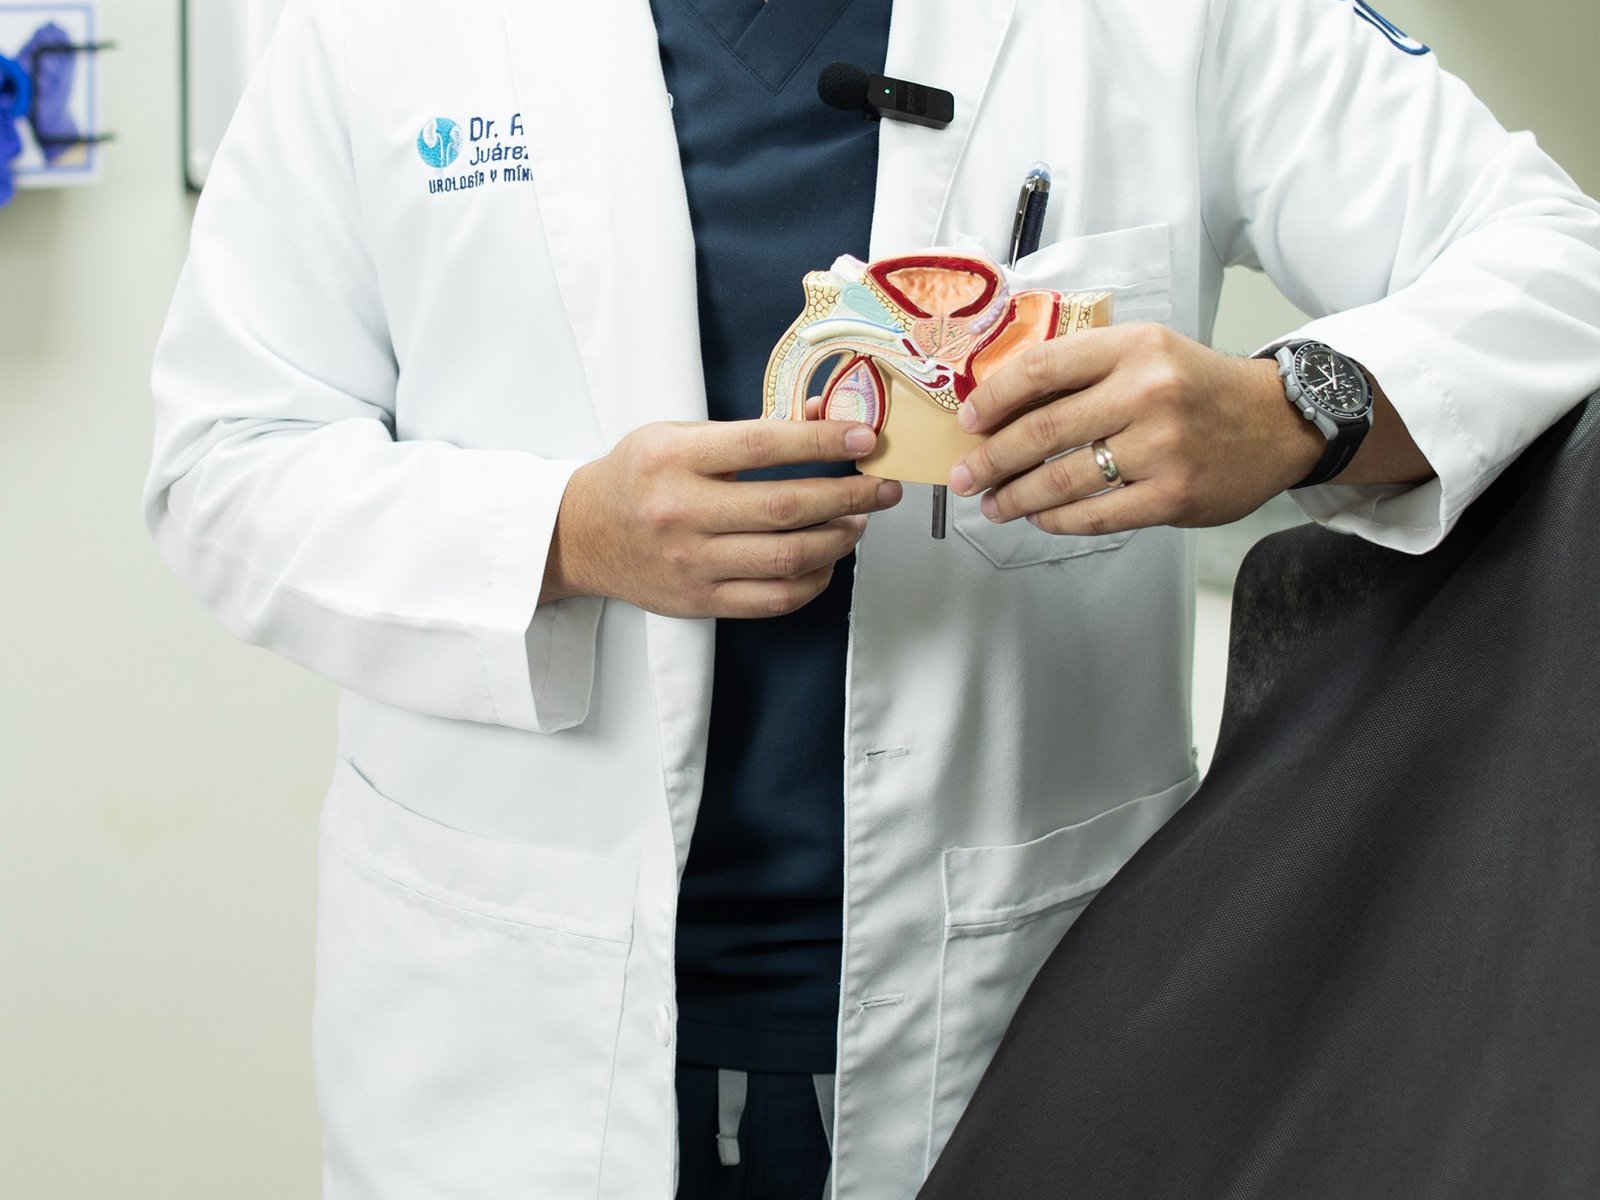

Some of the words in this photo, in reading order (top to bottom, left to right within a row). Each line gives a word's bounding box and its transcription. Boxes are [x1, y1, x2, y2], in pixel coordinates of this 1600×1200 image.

[470, 116, 498, 142] Dr.
[510, 112, 524, 136] A
[428, 170, 485, 194] UROLOGÍA
